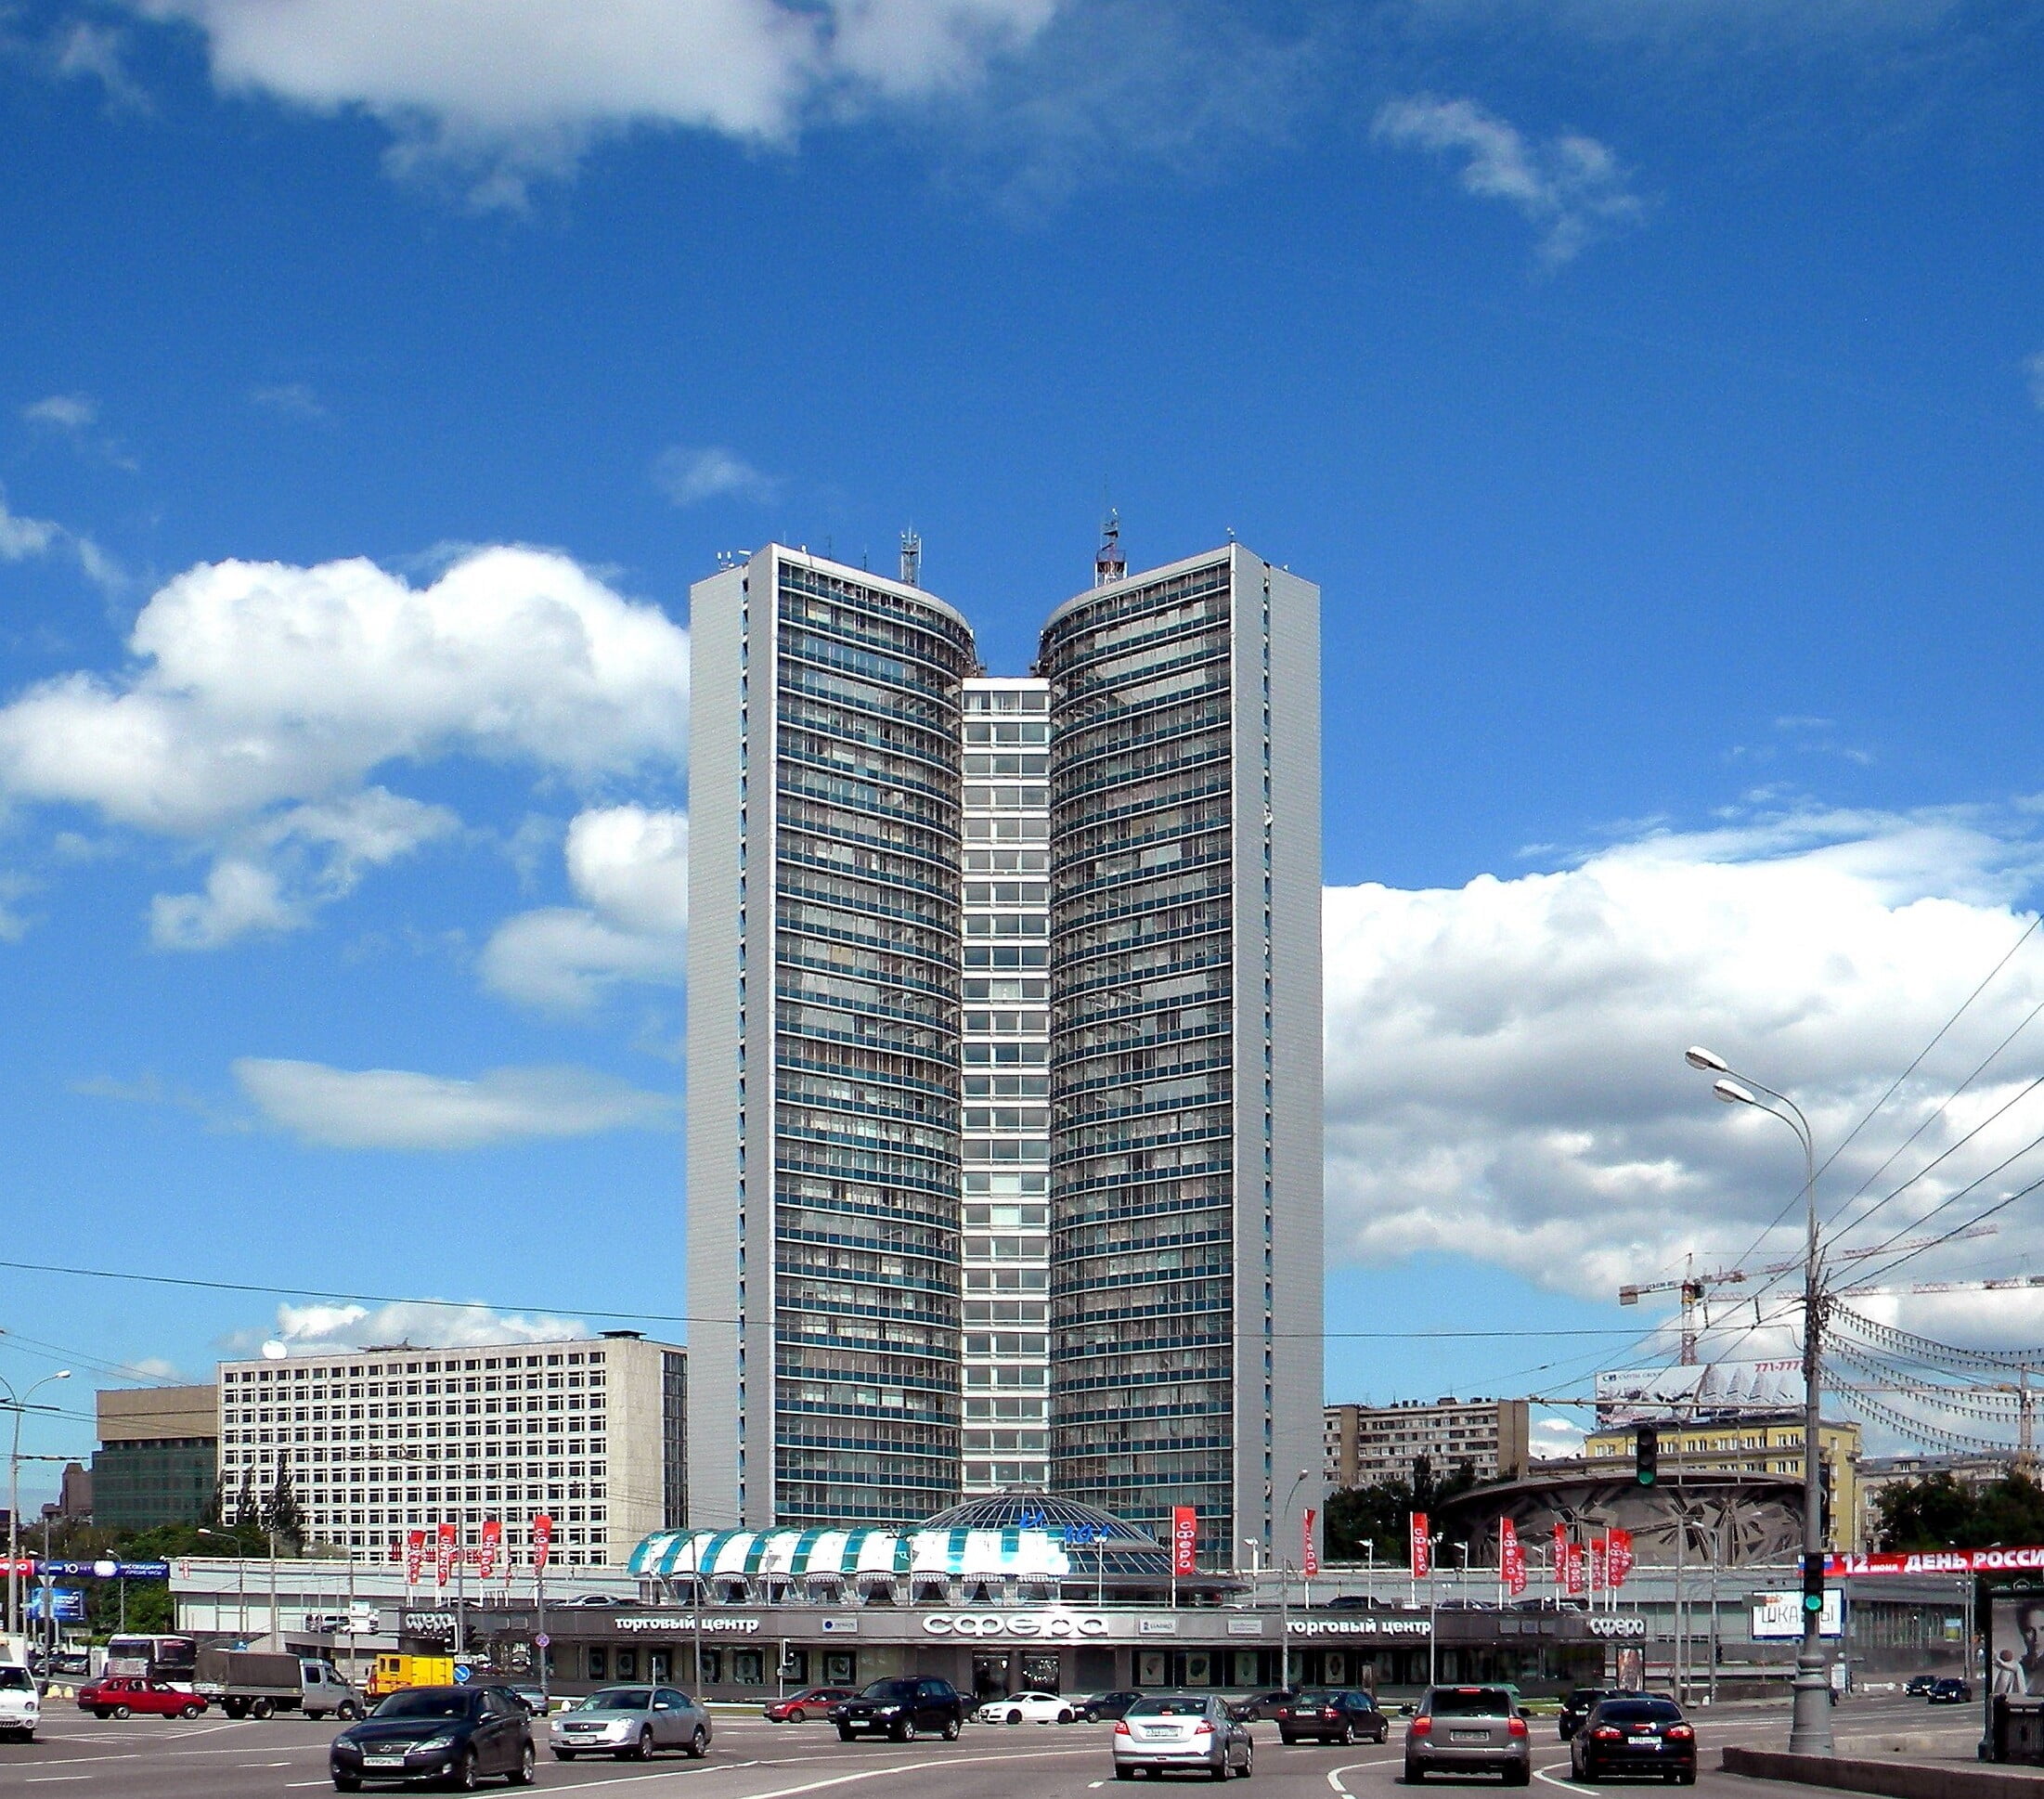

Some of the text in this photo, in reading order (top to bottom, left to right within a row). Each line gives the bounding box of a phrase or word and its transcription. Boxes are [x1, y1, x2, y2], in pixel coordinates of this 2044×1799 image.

[1178, 1521, 1196, 1569] сфера
[1414, 1528, 1427, 1572] сфера
[64, 1563, 78, 1573] 10
[1841, 1553, 1869, 1573] 12
[1904, 1552, 1968, 1573] ДЕНЬ
[1973, 1549, 2044, 1568] РОССИ
[406, 1612, 454, 1632] сфера
[1762, 1605, 1834, 1623] ШКАЫ
[614, 1615, 759, 1634] торговый центр
[922, 1613, 1109, 1637] сфера
[1286, 1618, 1432, 1637] торговый центр
[1590, 1617, 1645, 1637] сфера
